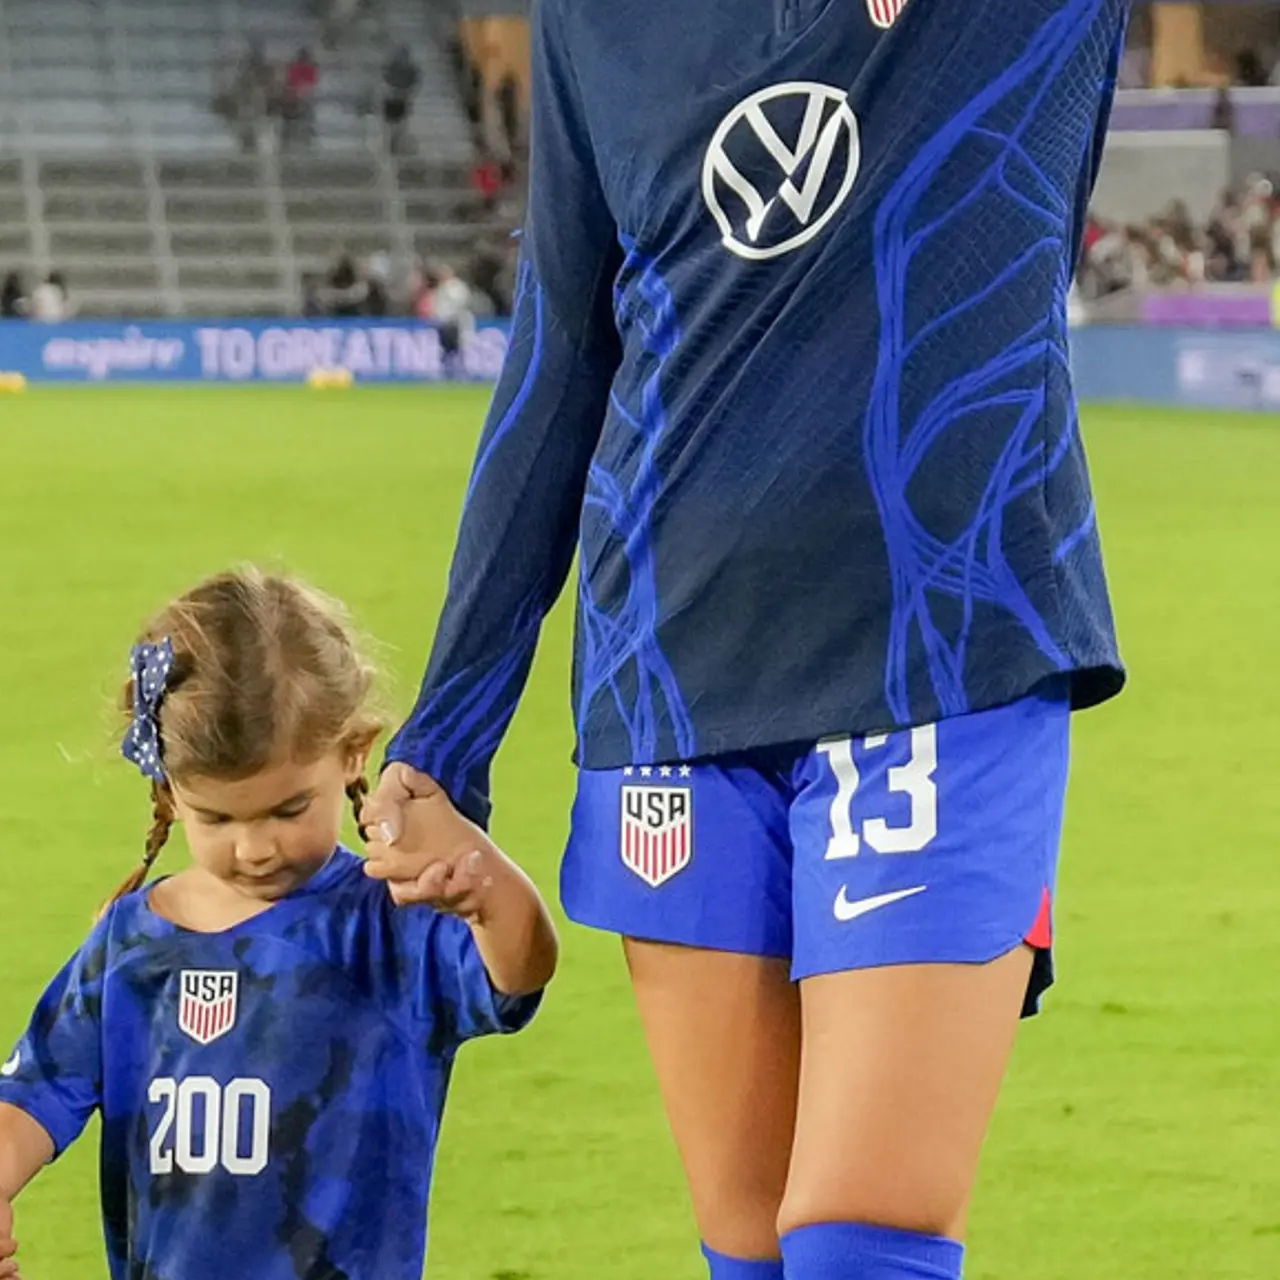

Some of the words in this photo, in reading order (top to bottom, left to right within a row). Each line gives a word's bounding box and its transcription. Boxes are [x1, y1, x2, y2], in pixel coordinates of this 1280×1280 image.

[625, 791, 687, 828] USA
[816, 723, 938, 860] 13
[185, 975, 233, 1003] USA
[147, 1076, 270, 1175] 200
